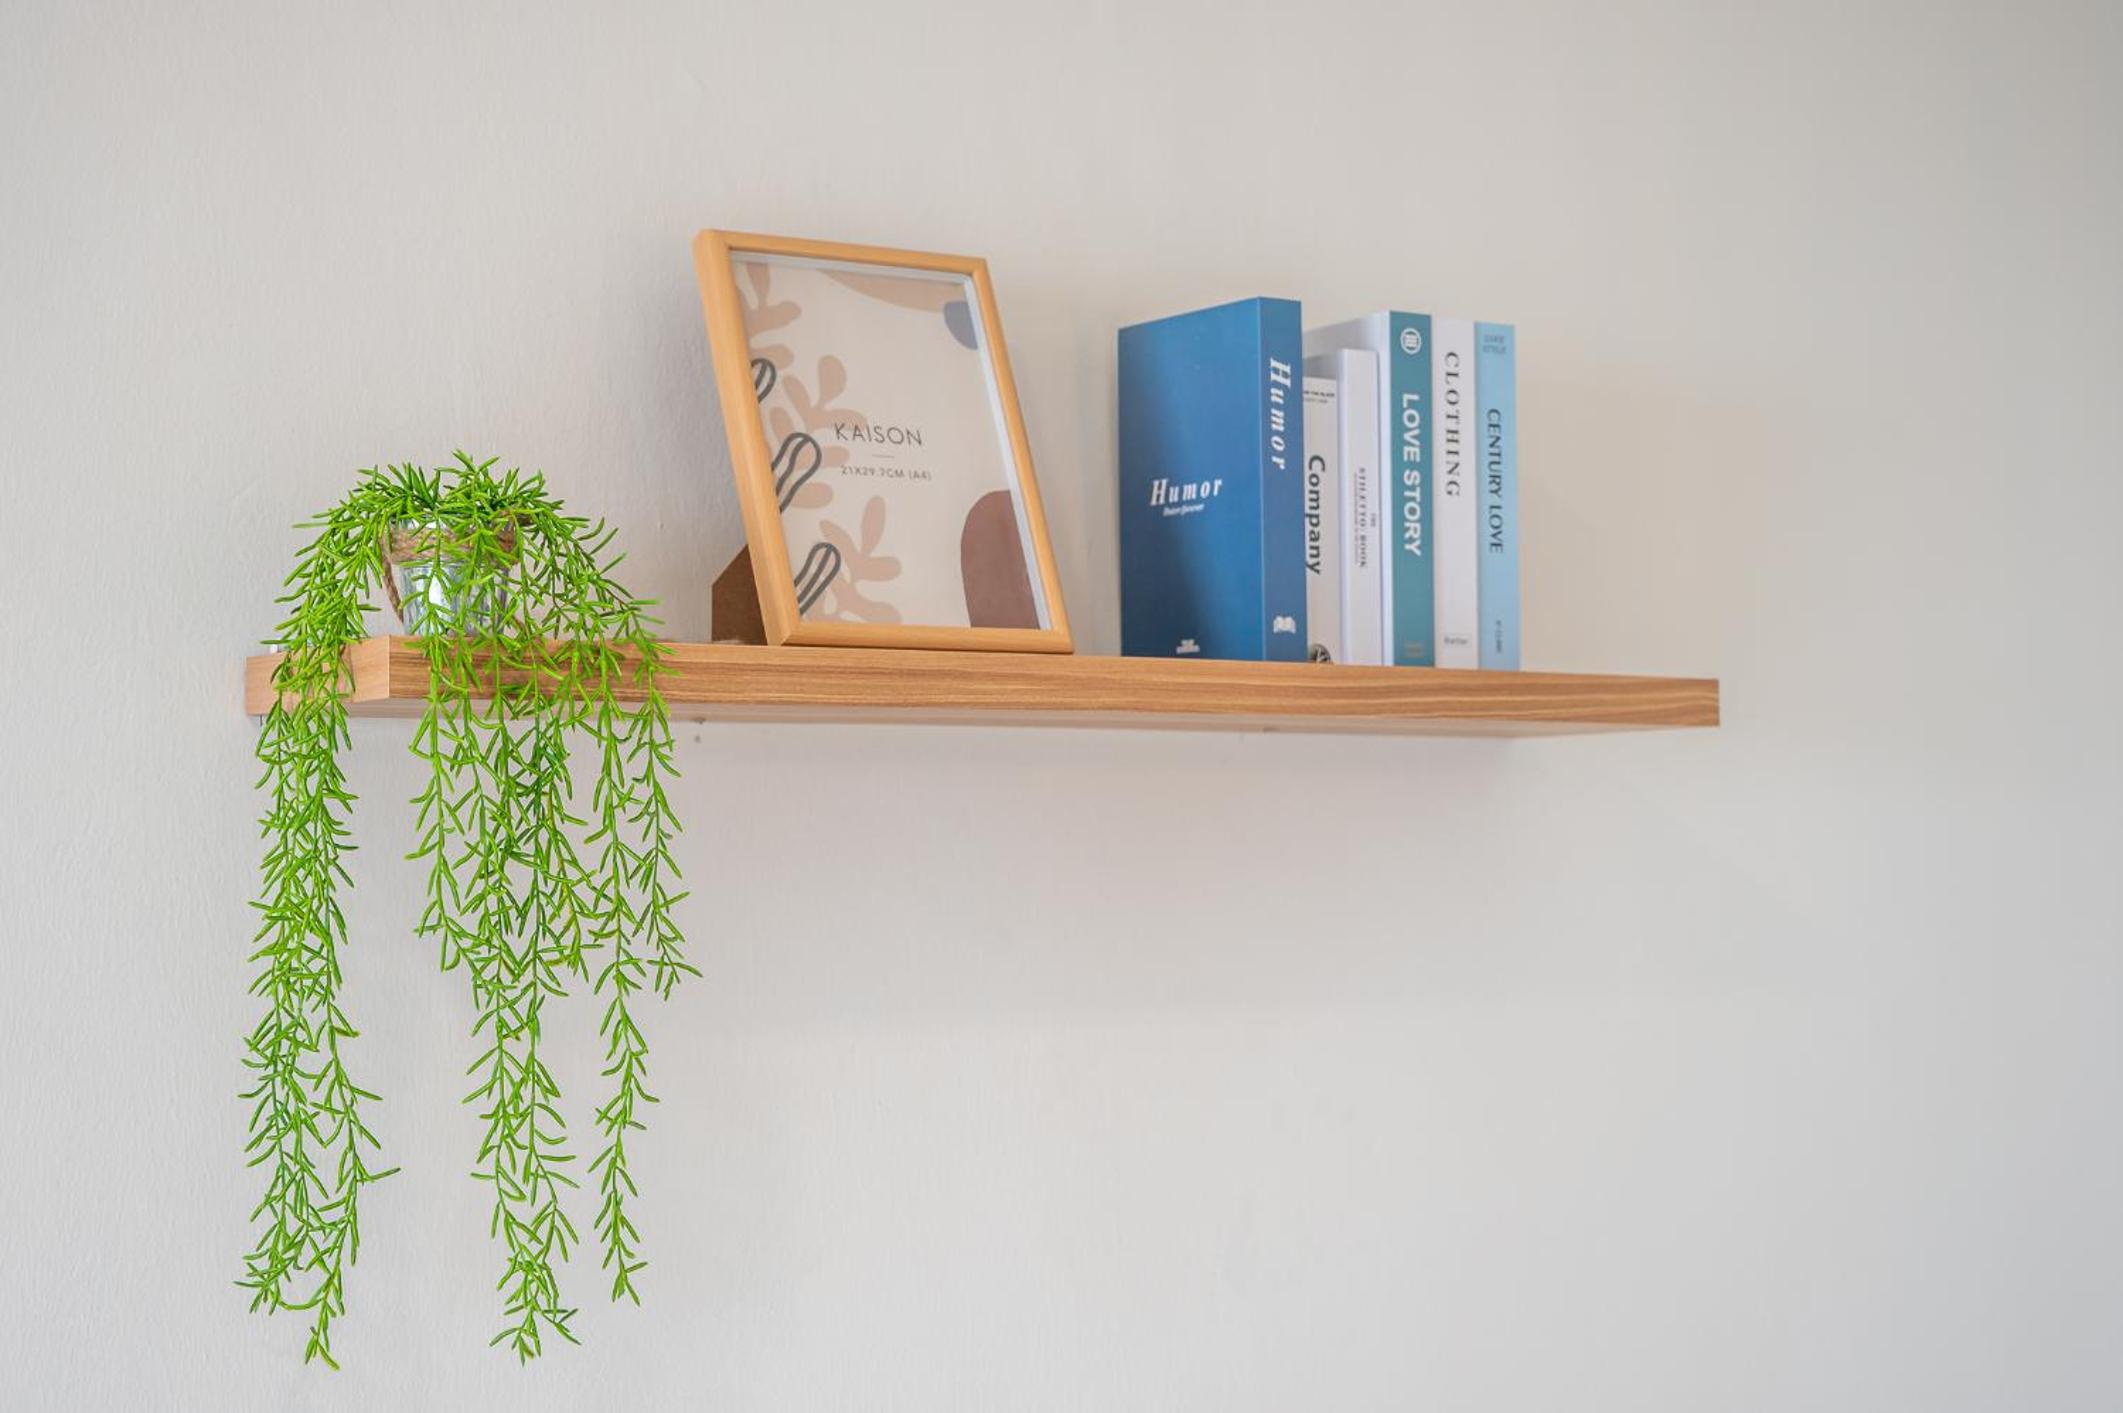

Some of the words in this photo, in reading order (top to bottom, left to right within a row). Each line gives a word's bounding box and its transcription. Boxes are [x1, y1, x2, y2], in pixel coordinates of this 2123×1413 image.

[835, 423, 922, 446] KAISON
[1269, 358, 1291, 470] Humor
[1403, 393, 1420, 462] LOVE
[1445, 352, 1460, 496] CLOTHING
[1487, 408, 1502, 499] CENTURY
[1150, 478, 1222, 507] Humor
[1305, 454, 1326, 575] Company
[1404, 469, 1421, 557] STORY
[1489, 505, 1504, 554] LOVE
